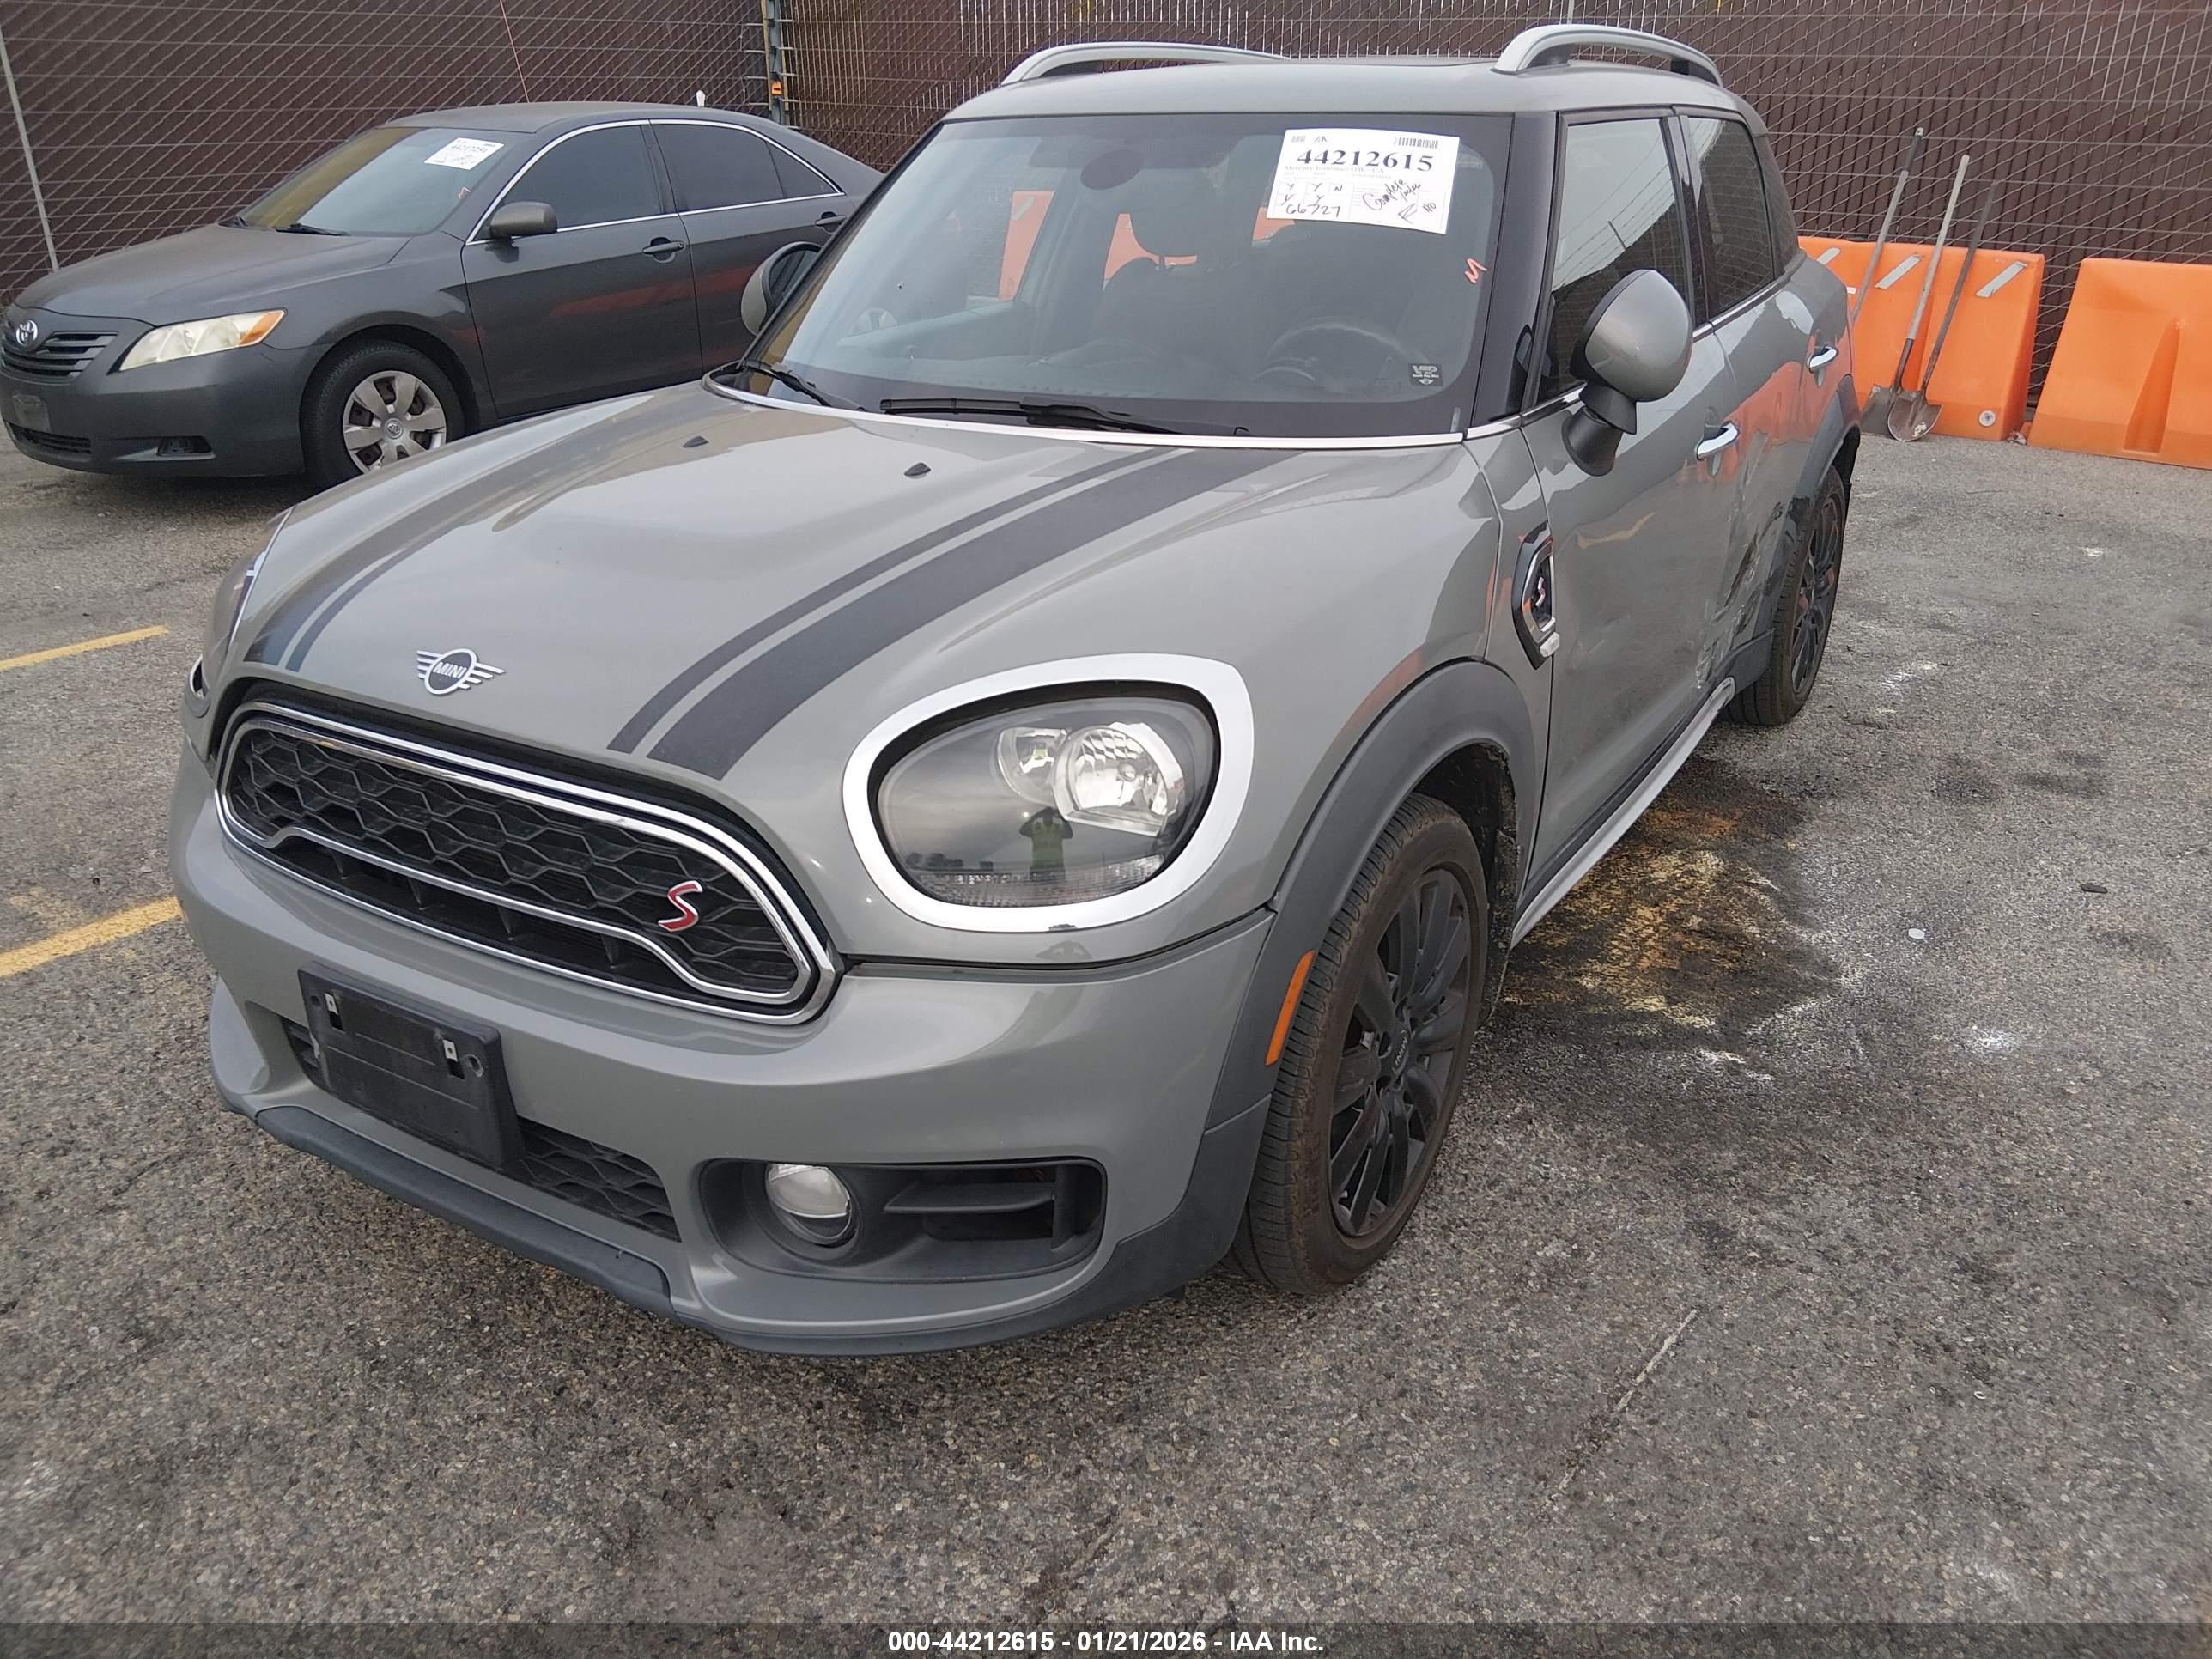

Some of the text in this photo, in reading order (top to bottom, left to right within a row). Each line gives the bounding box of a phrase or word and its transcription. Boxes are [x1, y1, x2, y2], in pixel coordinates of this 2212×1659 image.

[1297, 149, 1434, 172] 44212615
[432, 661, 468, 678] MINI
[658, 880, 703, 932] S
